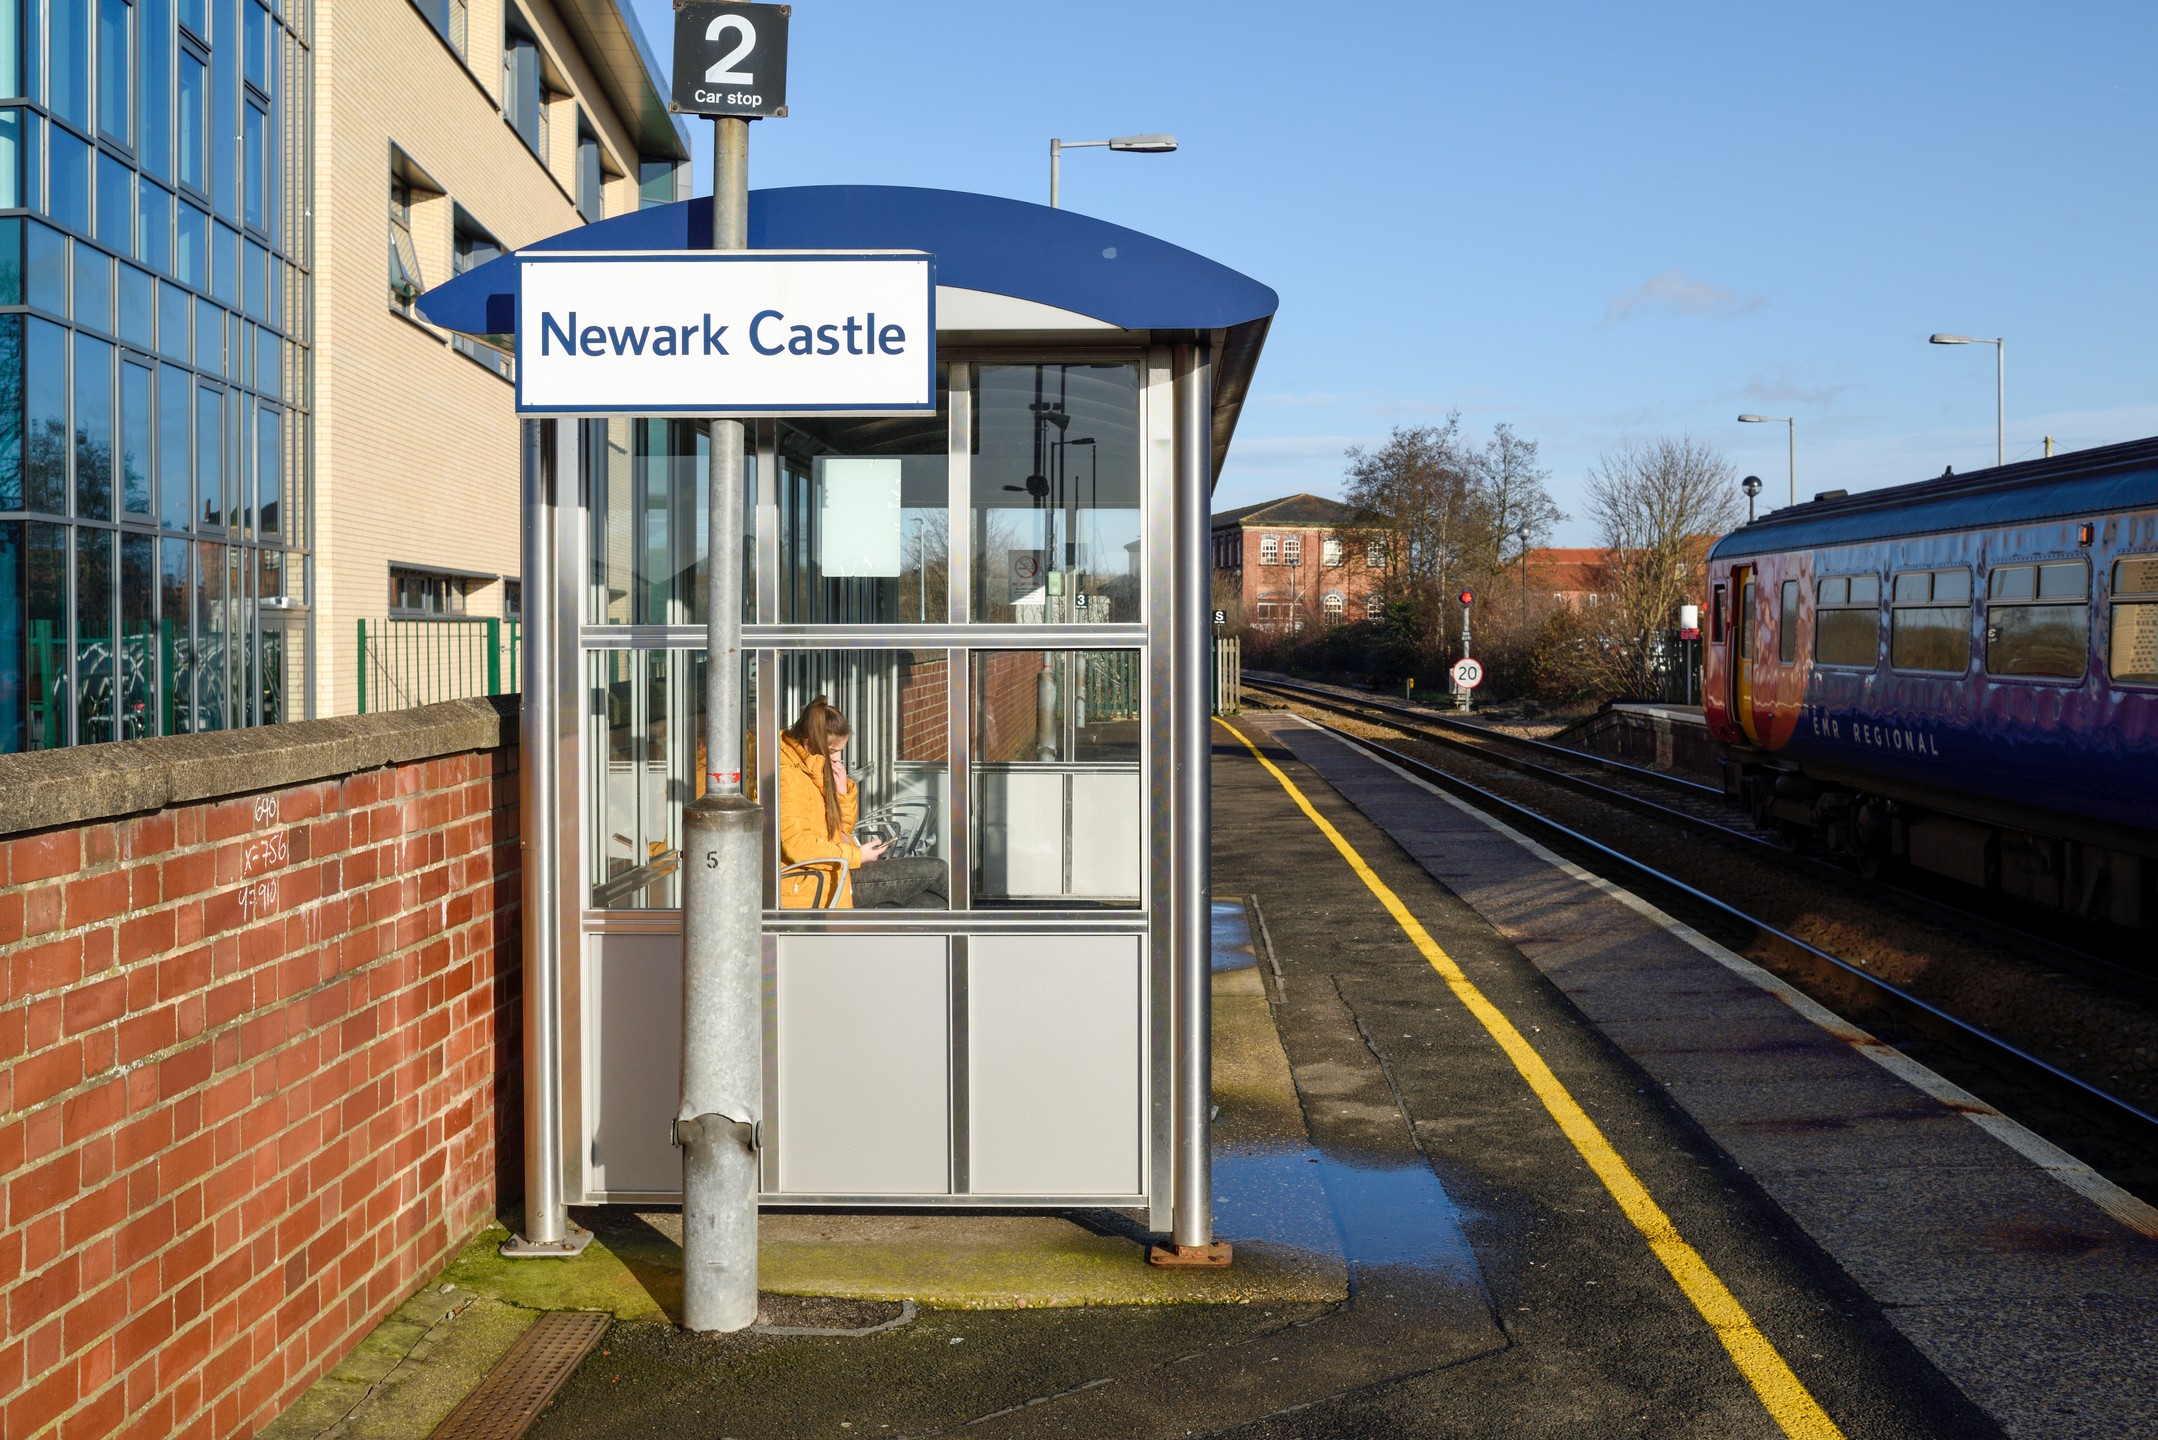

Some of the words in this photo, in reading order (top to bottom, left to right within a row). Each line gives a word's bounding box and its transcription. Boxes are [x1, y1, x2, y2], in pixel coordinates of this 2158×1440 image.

[705, 14, 757, 85] 2
[694, 89, 722, 104] Car
[727, 91, 763, 108] stop
[541, 311, 730, 357] Newark
[748, 309, 906, 357] Castle
[1077, 594, 1085, 605] 3
[1216, 611, 1224, 621] S
[1459, 666, 1477, 680] 20
[1813, 716, 1840, 739] EMR
[1853, 722, 1939, 756] REGIONAL
[707, 851, 718, 869] 5
